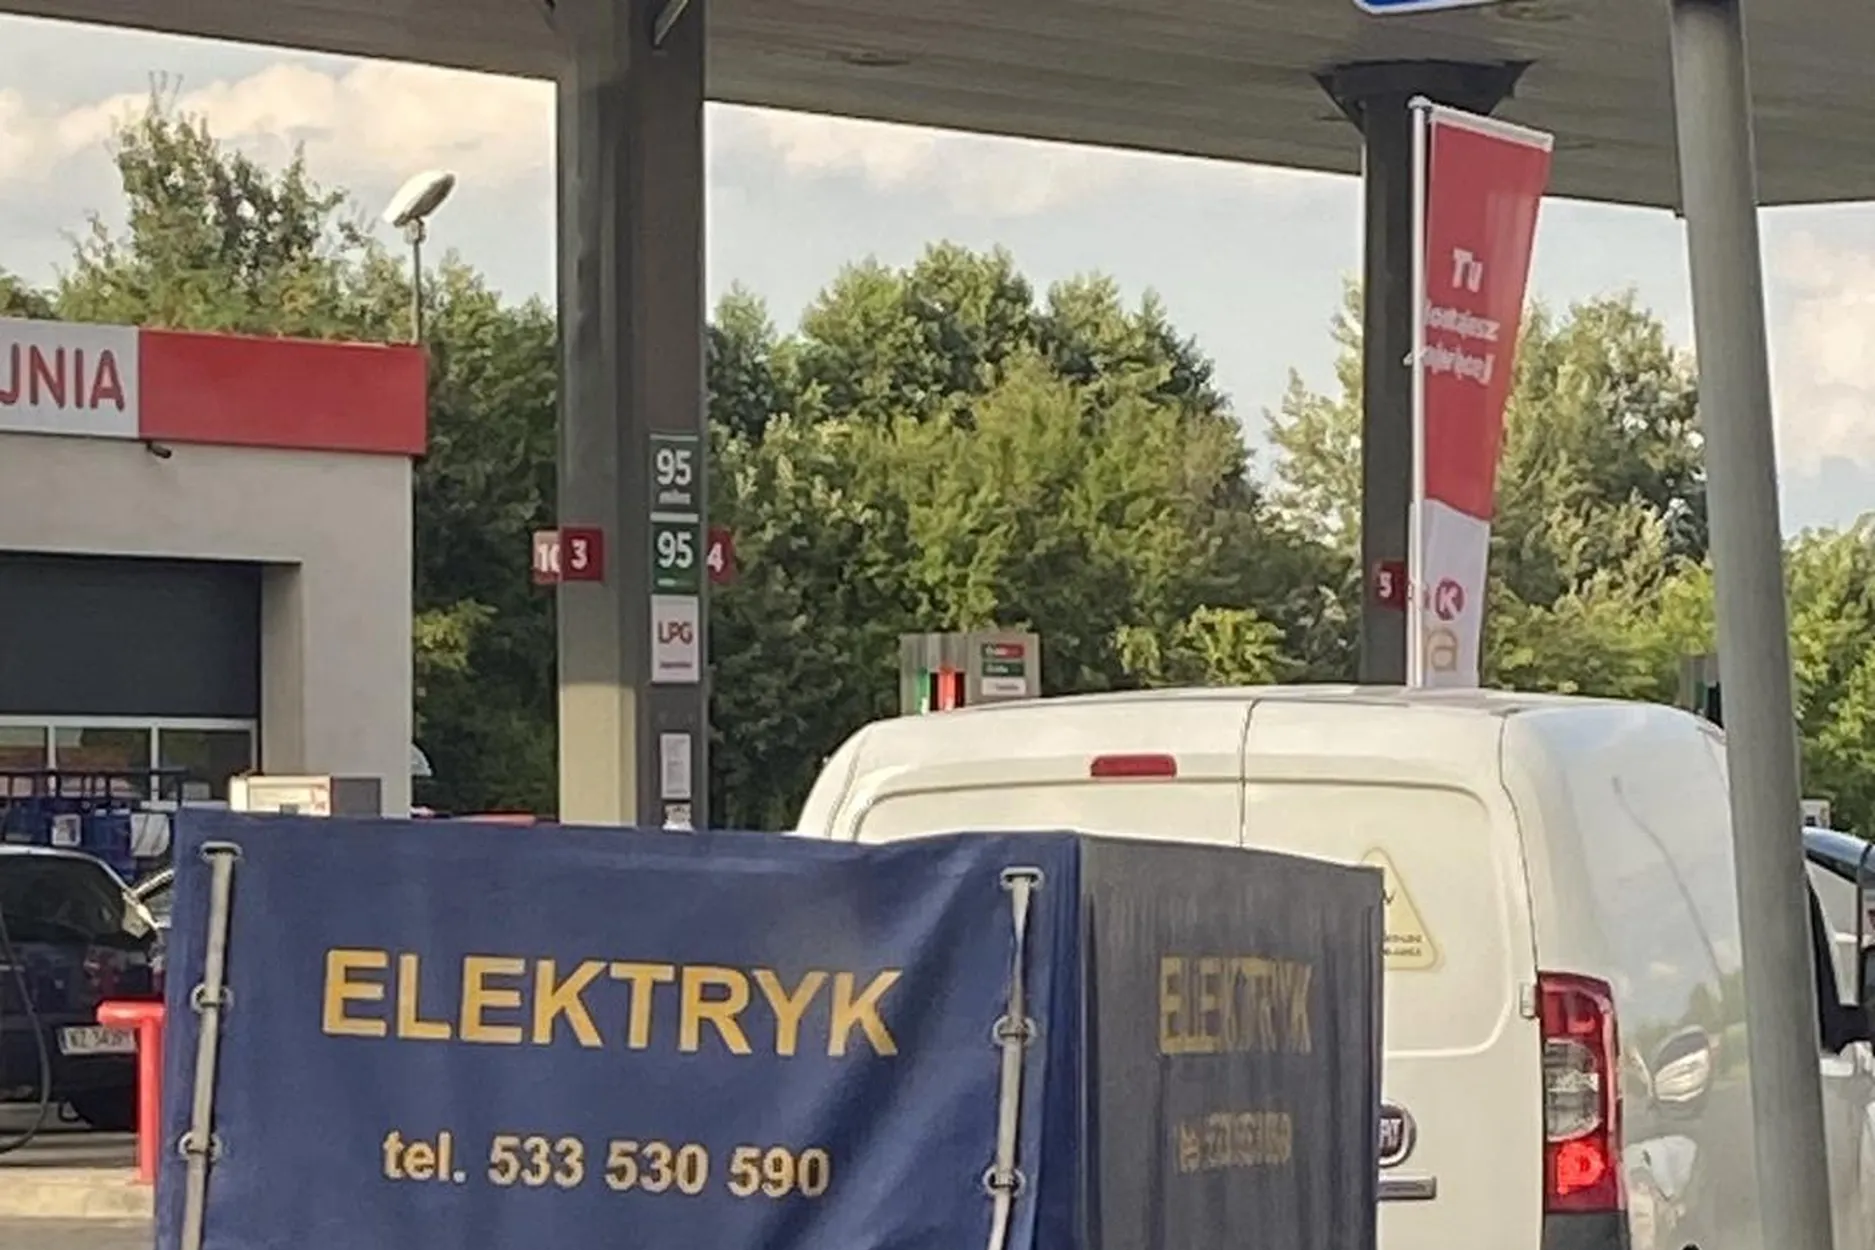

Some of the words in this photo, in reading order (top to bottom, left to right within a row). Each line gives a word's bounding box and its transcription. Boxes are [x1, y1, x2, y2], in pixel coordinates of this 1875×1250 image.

[656, 449, 692, 486] 95
[571, 539, 588, 570] 3
[657, 531, 694, 568] 95
[706, 542, 724, 573] 4
[657, 621, 693, 645] LPG
[323, 949, 901, 1056] ELEKTRYK
[382, 1130, 467, 1184] tel.
[487, 1134, 585, 1190] 533
[604, 1139, 708, 1195] 530
[728, 1145, 832, 1198] 590
